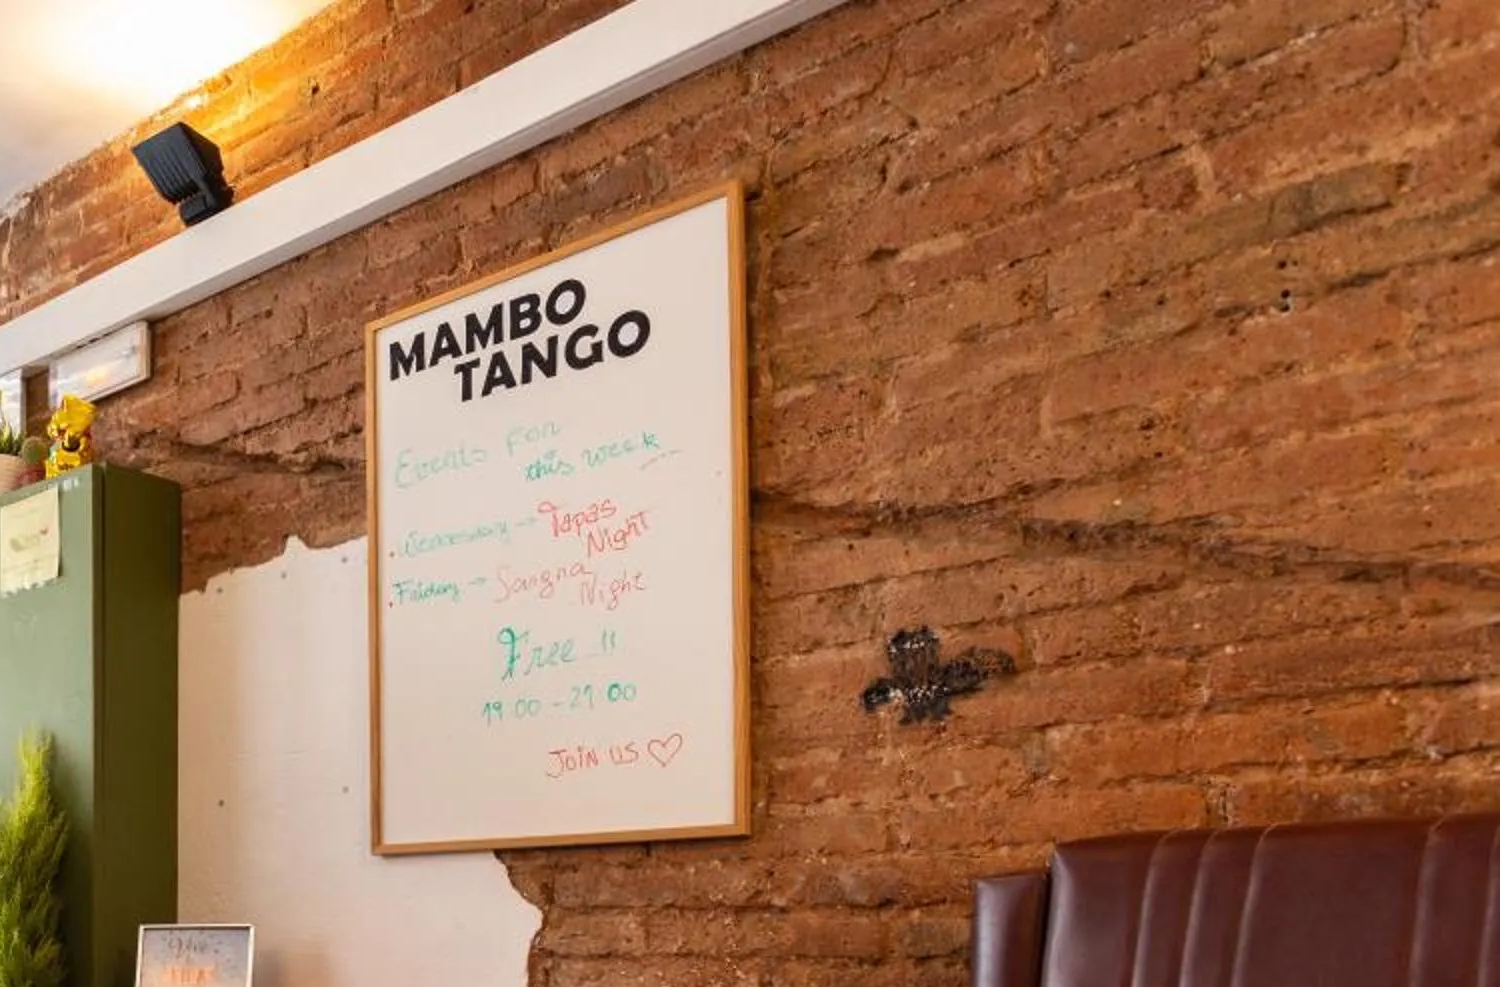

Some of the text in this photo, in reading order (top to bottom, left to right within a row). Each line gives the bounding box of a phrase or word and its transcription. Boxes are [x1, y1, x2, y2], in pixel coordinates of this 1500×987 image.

[389, 278, 587, 381] MAMBO
[454, 309, 651, 402] TANGO
[394, 446, 488, 489] Events
[524, 431, 660, 482] this week
[538, 499, 617, 538] Tapas
[497, 626, 578, 681] Free
[608, 741, 640, 765] US
